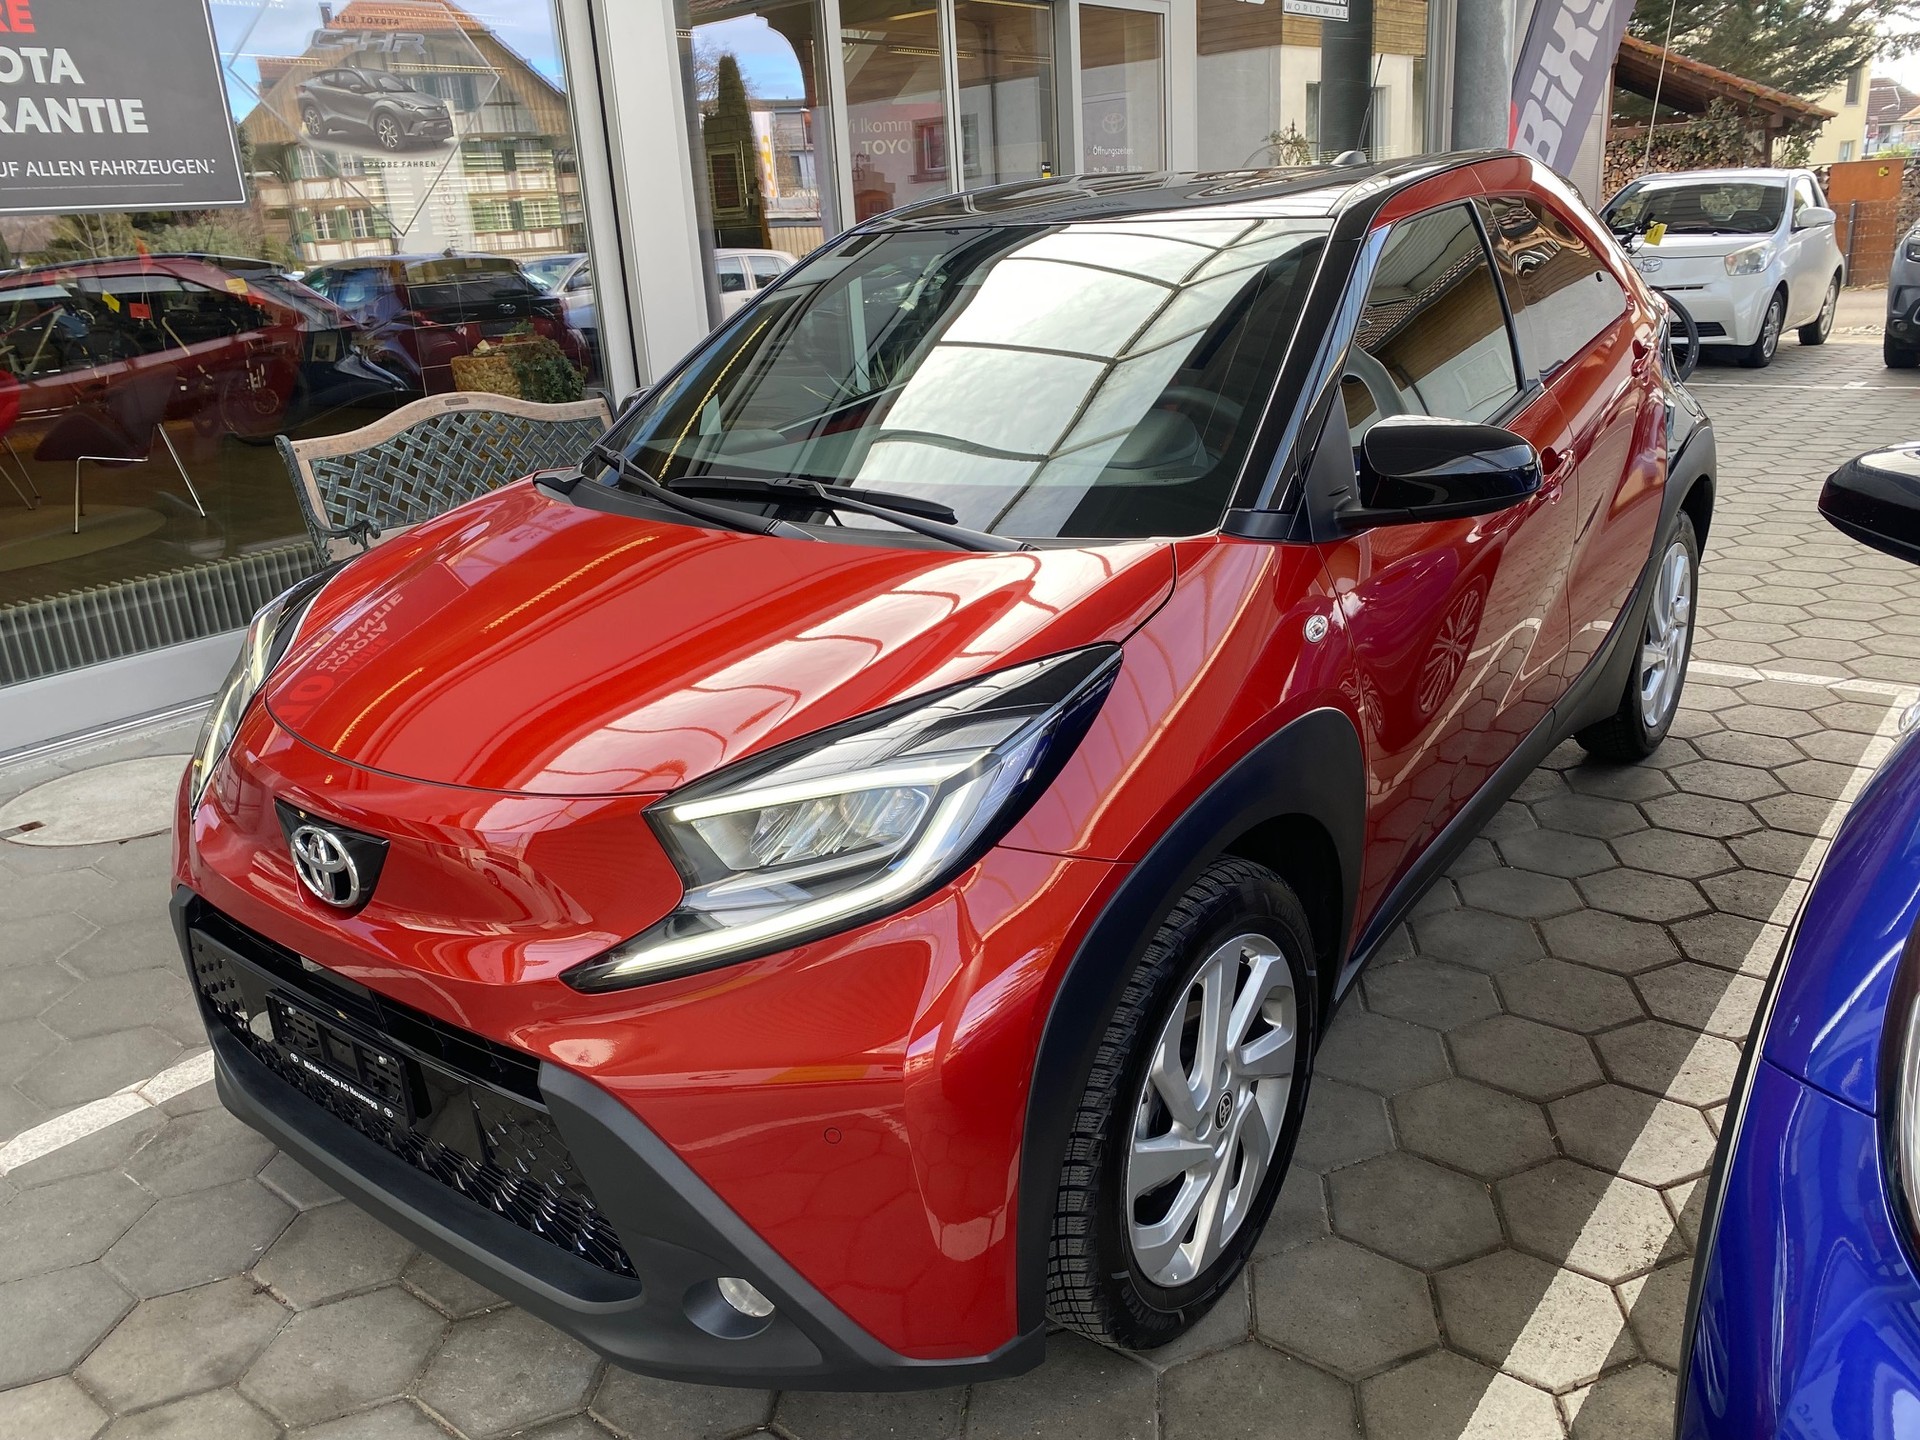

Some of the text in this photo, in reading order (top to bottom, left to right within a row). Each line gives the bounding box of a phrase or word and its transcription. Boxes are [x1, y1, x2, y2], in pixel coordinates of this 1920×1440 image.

[1286, 2, 1347, 17] WORLDWIDE
[334, 15, 400, 26] NEW TOYOTA
[0, 46, 85, 84] OTA
[27, 160, 85, 177] ALLEN
[343, 160, 437, 169] HIER PROBE FAHREN
